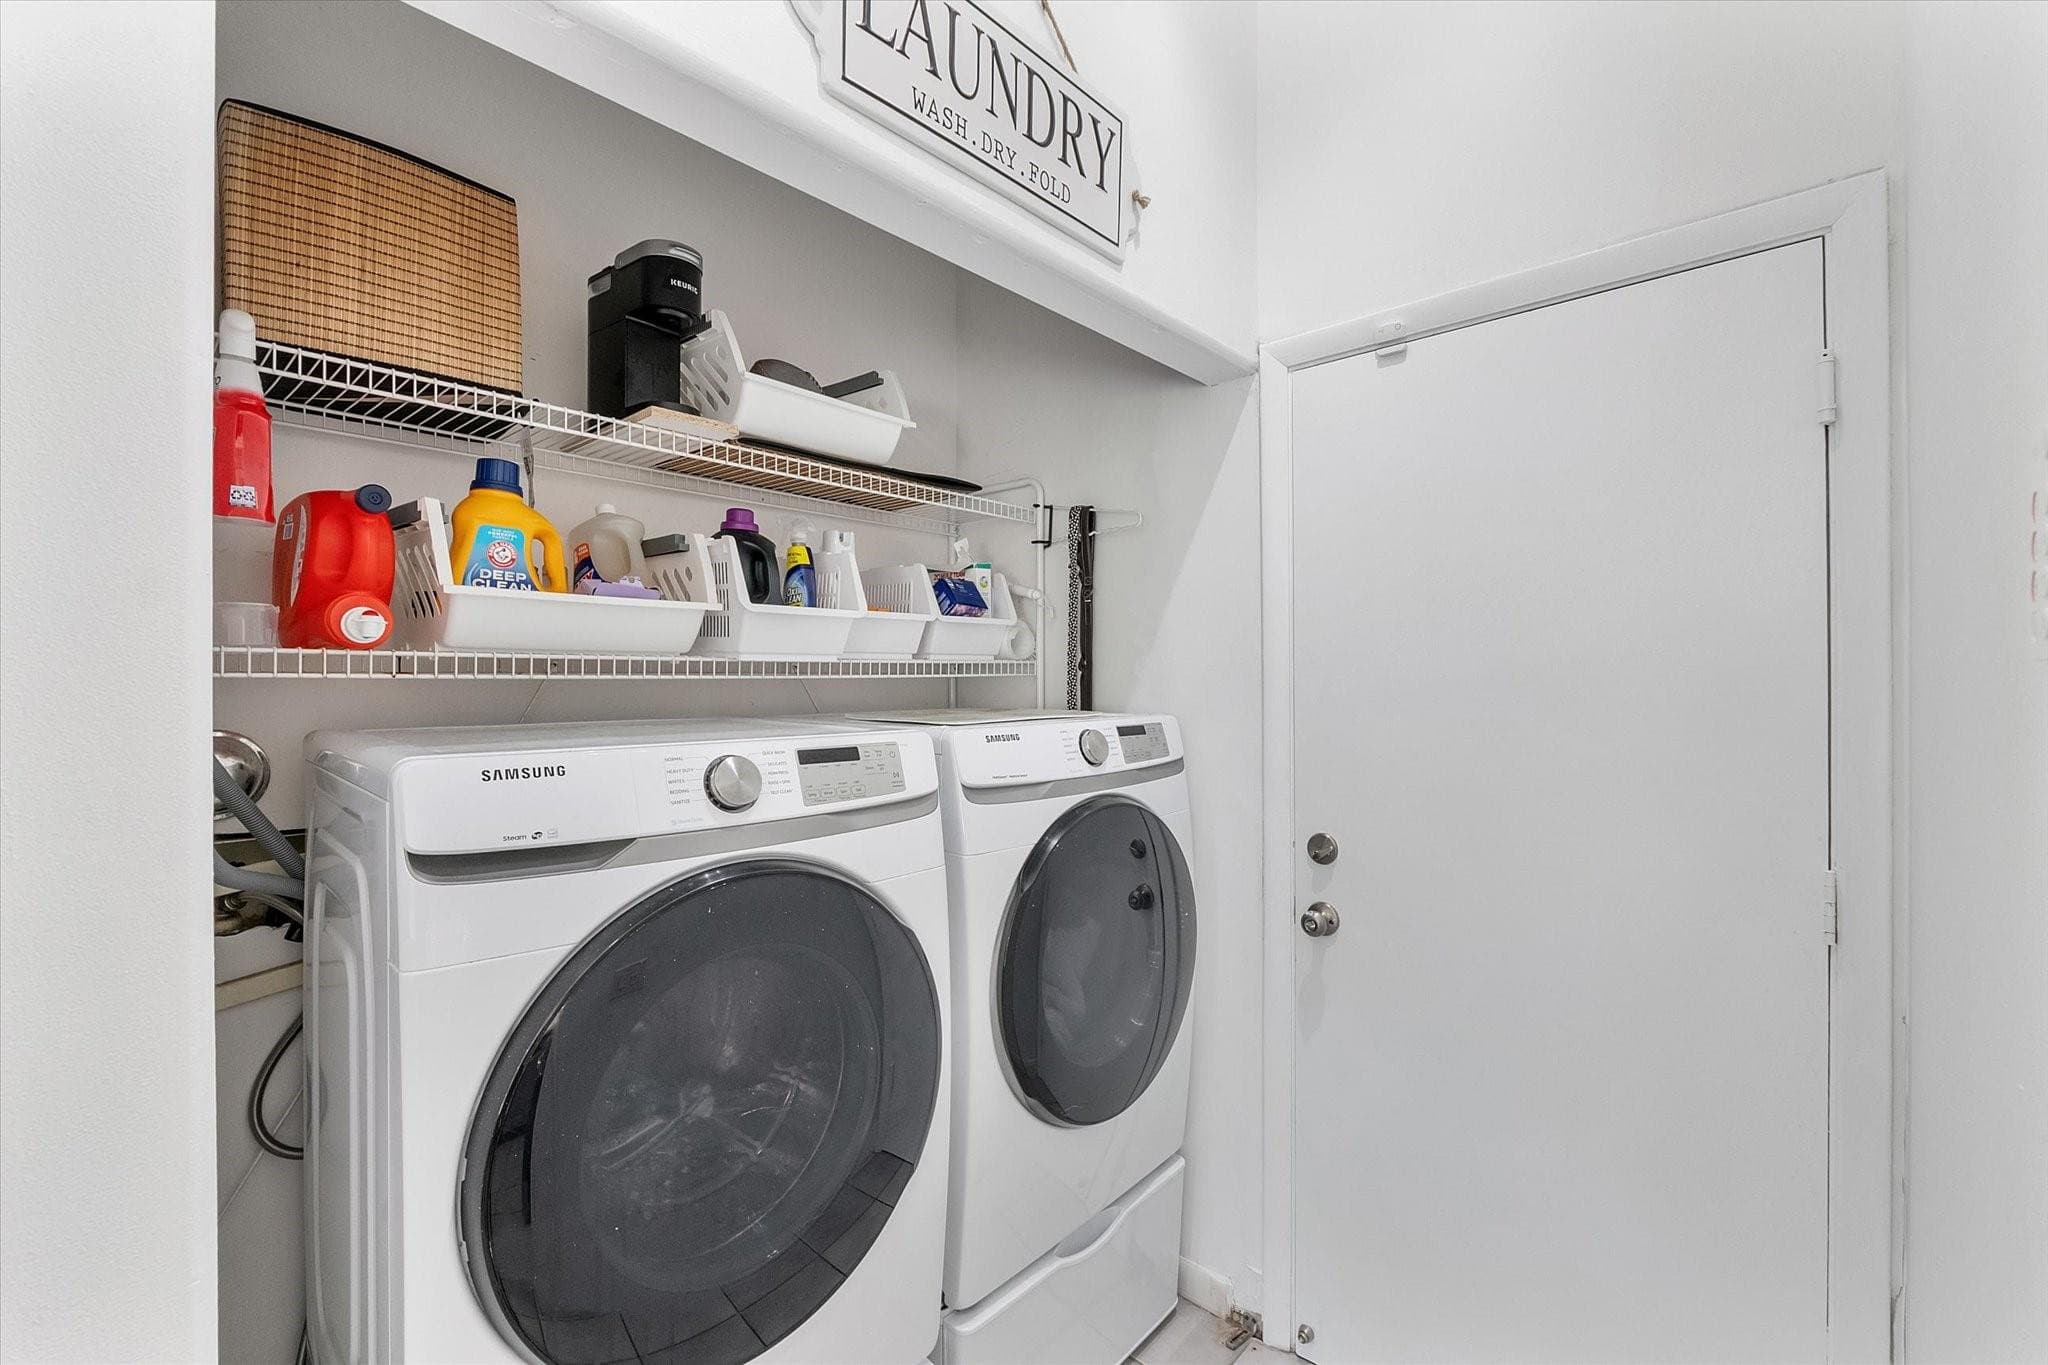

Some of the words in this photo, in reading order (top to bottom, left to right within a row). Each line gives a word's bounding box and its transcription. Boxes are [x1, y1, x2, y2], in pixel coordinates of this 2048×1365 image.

[670, 278, 698, 295] KEURIG
[480, 569, 526, 582] DEEP
[472, 579, 531, 591] CLEAN
[985, 733, 1020, 743] SAMSUNG
[481, 765, 566, 782] SAMSUNG
